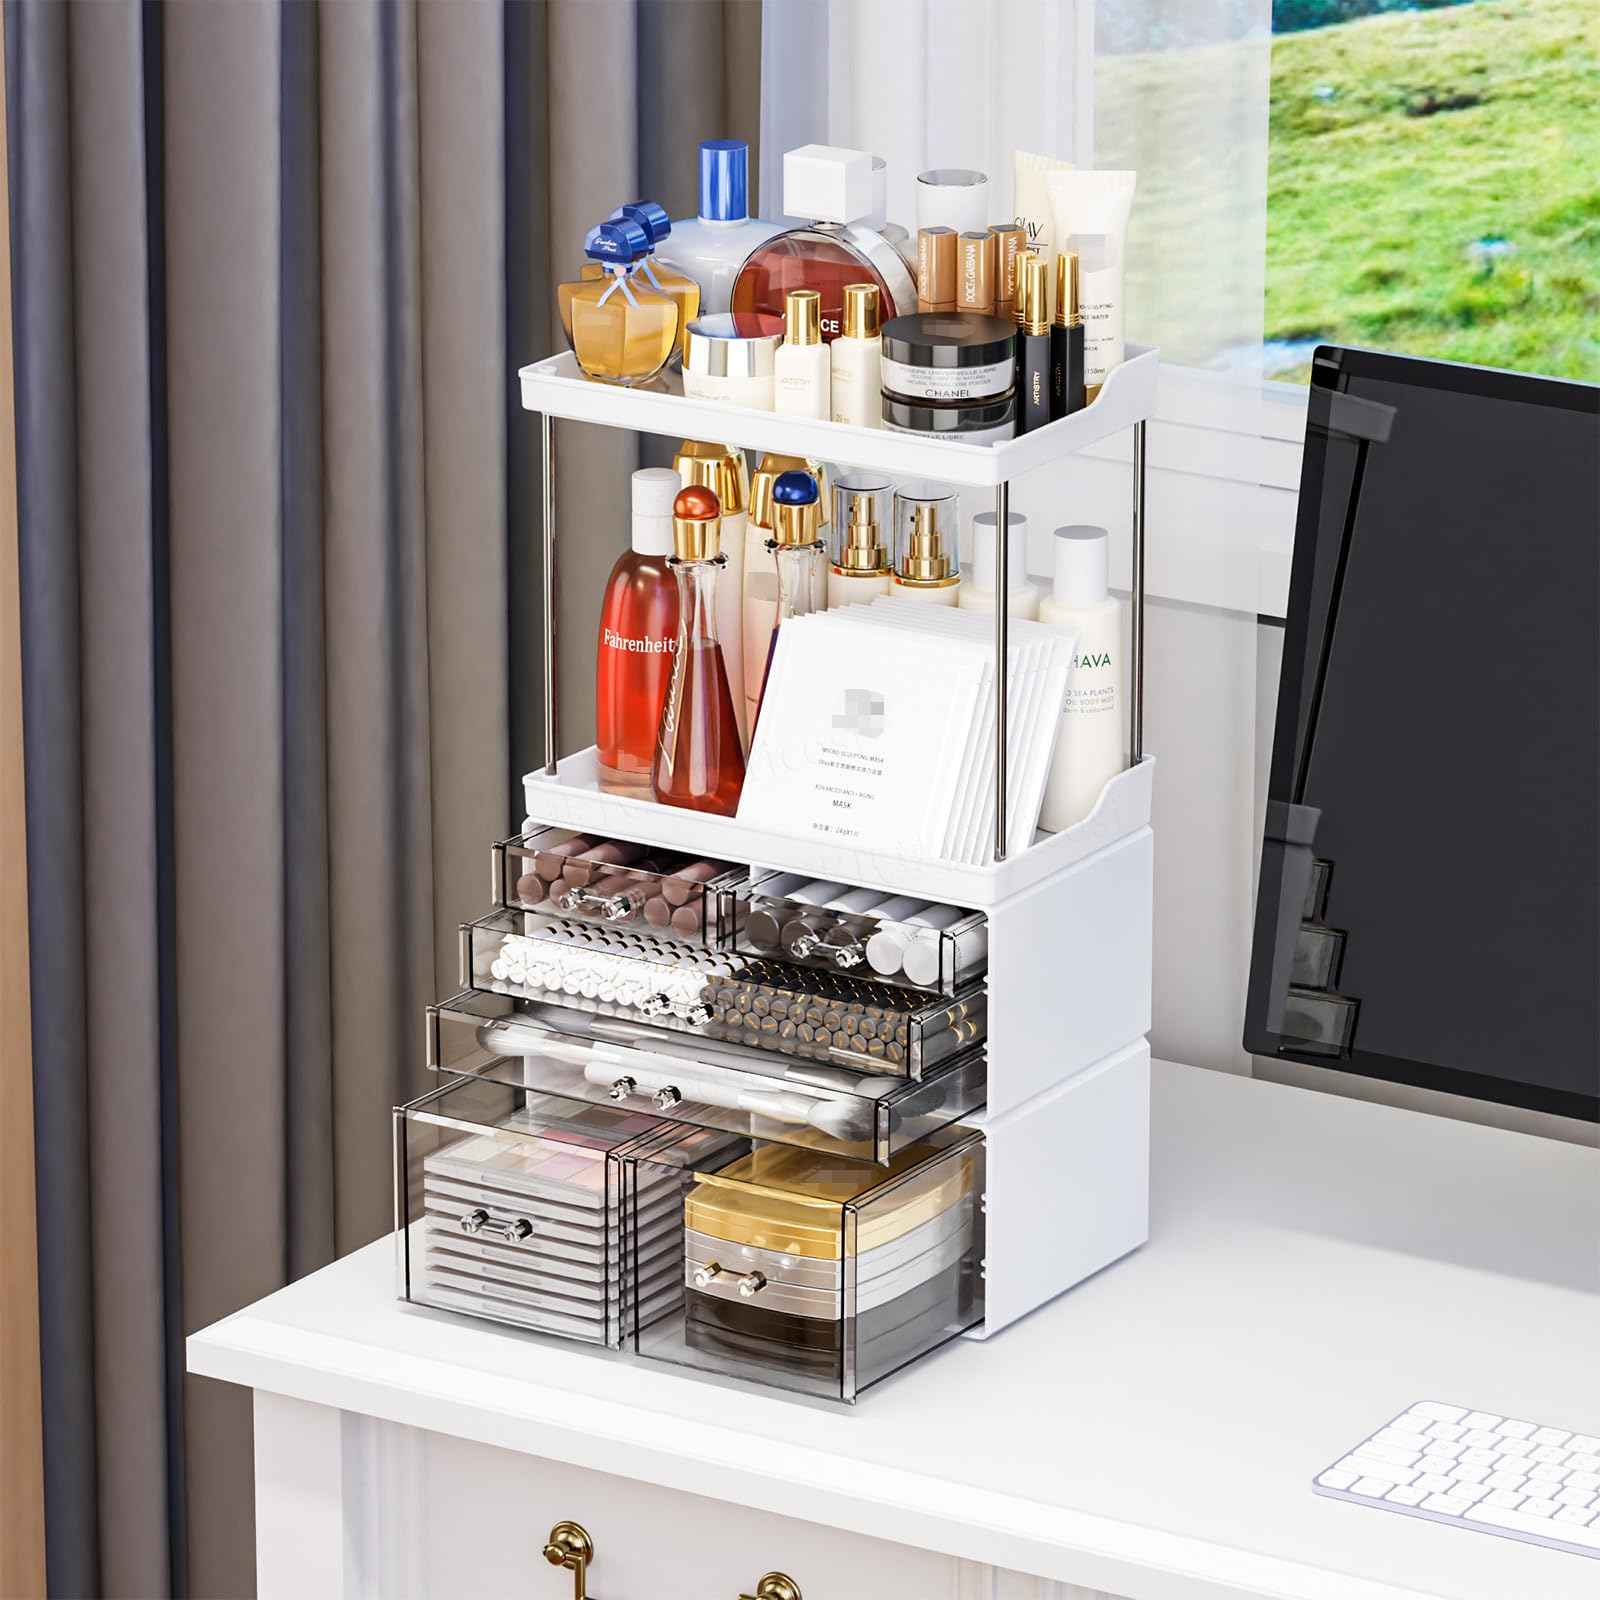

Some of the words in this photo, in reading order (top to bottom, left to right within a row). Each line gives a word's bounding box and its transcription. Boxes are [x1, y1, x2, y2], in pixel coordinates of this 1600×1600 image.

[924, 389, 970, 398] CHANEL
[604, 629, 675, 653] Fahrenheit
[832, 800, 852, 808] MASK
